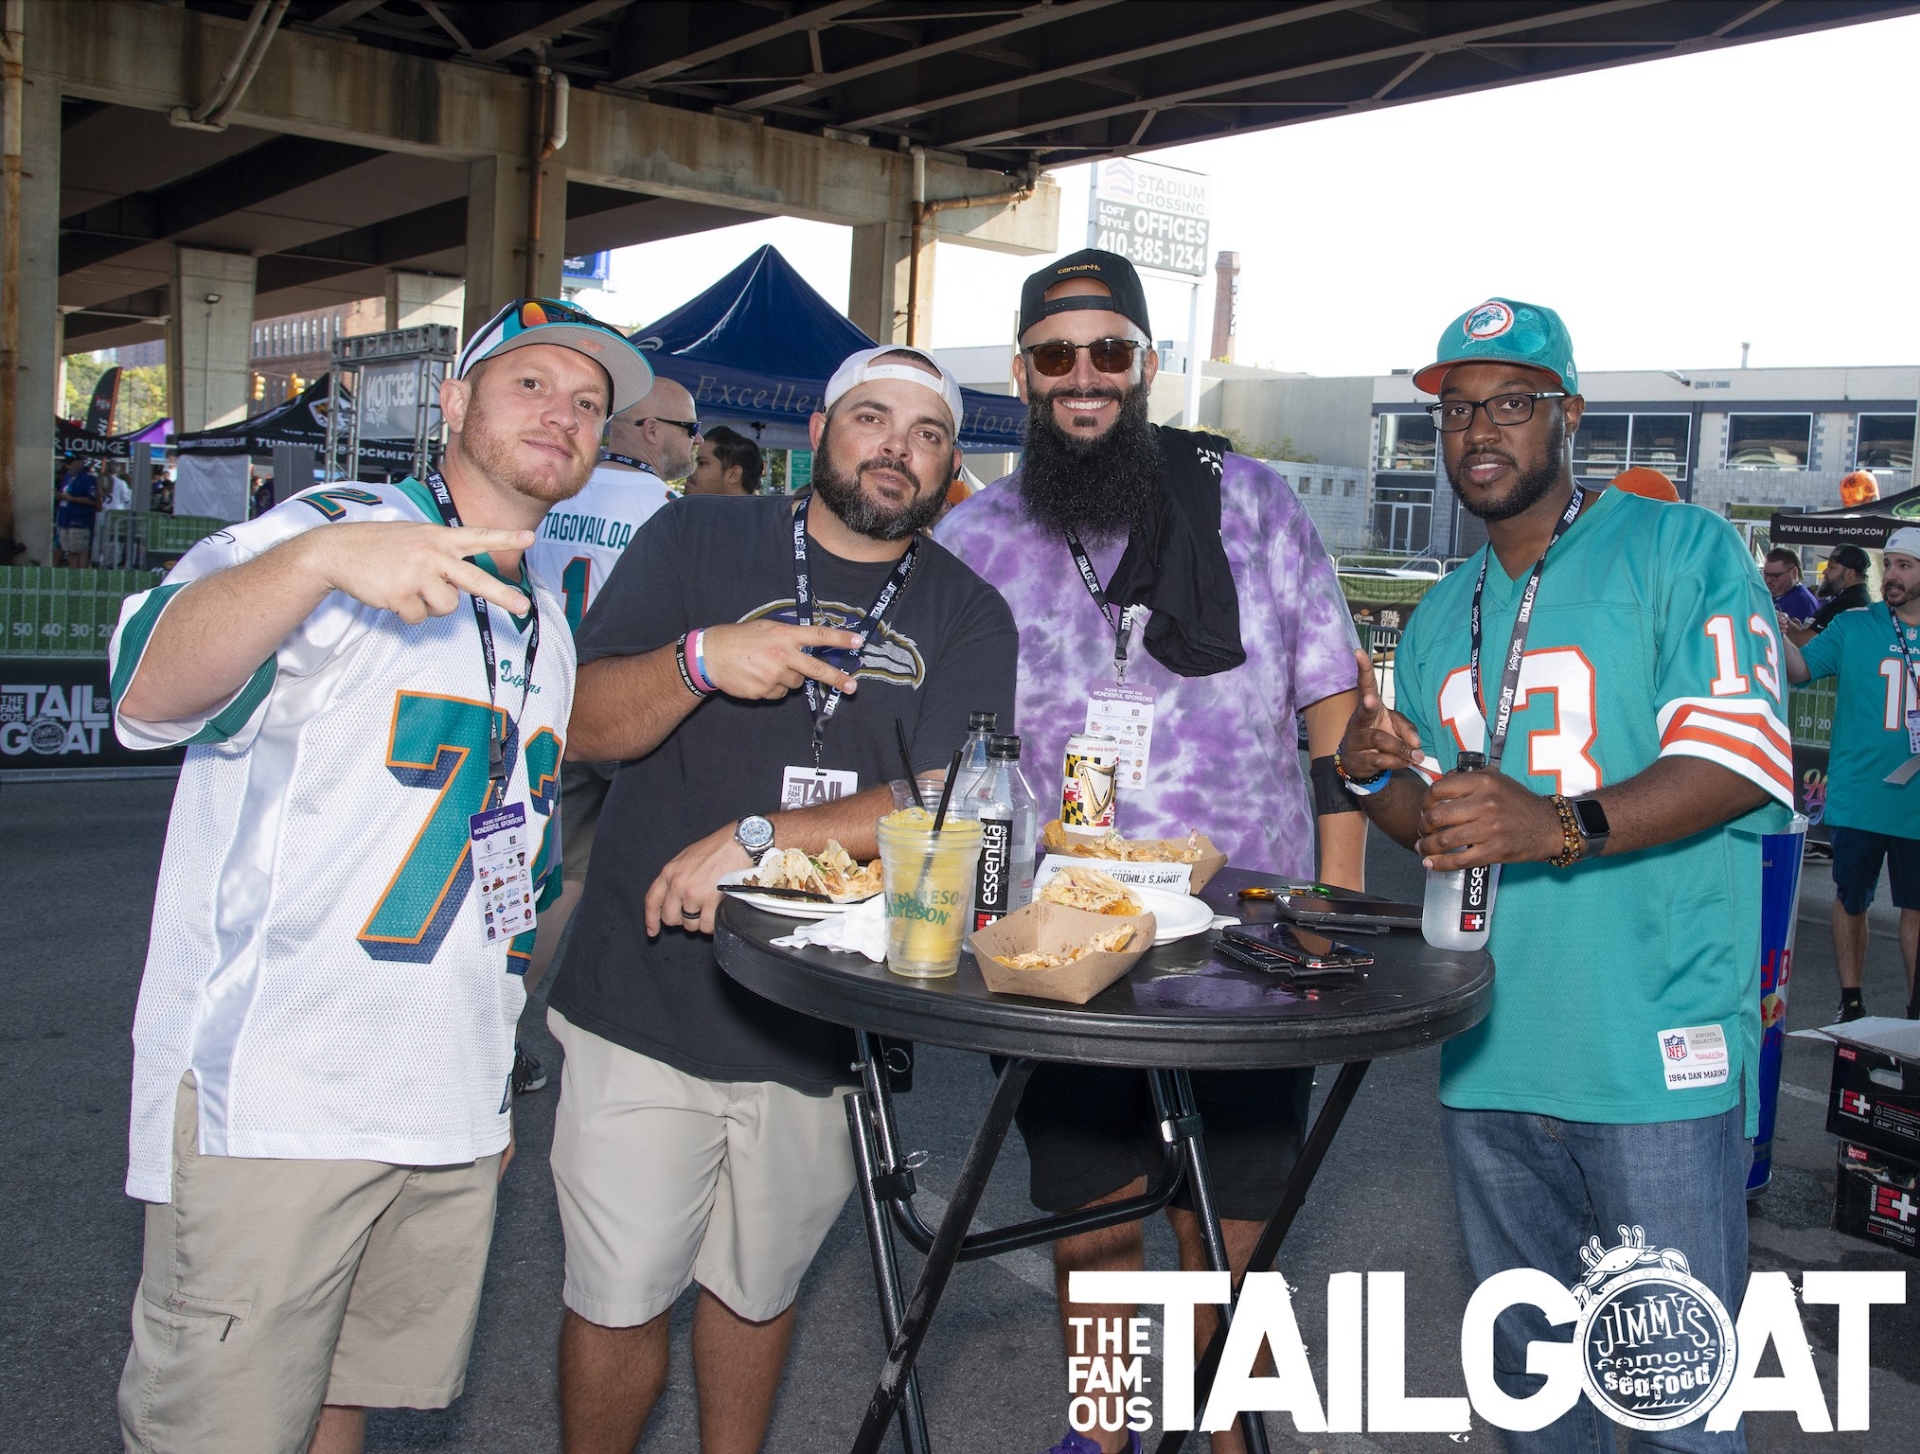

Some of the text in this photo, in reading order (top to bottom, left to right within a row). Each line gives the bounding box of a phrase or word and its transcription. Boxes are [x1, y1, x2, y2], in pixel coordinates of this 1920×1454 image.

[1137, 174, 1205, 201] STADIUM
[1100, 201, 1126, 217] LOFT
[1136, 191, 1205, 216] CROSSING
[1099, 214, 1130, 230] STYLE
[1134, 210, 1207, 245] OFFICES
[1097, 230, 1205, 272] 410-385-1234
[65, 438, 126, 455] LOUNGE
[543, 511, 632, 550] TAGOVAILOA
[1519, 575, 1539, 624] TAILGOAT
[13, 623, 33, 637] 50
[42, 624, 60, 637] 40
[70, 624, 89, 637] 30
[1704, 613, 1781, 703] 13
[1, 695, 24, 704] THE
[1, 685, 109, 721] TAIL
[1, 713, 24, 721] OUS
[1495, 685, 1515, 736] TAILGOAT
[1799, 716, 1832, 730] 10 20
[1, 721, 109, 755] GOAT
[788, 784, 801, 792] THE
[982, 824, 1002, 905] essentia
[1111, 872, 1148, 884] FAMOUS
[1469, 867, 1484, 906] esse
[1691, 1037, 1722, 1045] COLLECTION
[1694, 1031, 1716, 1039] REPLICA
[1668, 1045, 1686, 1058] NFL
[1668, 1068, 1727, 1082] 1984 DAN MARINO
